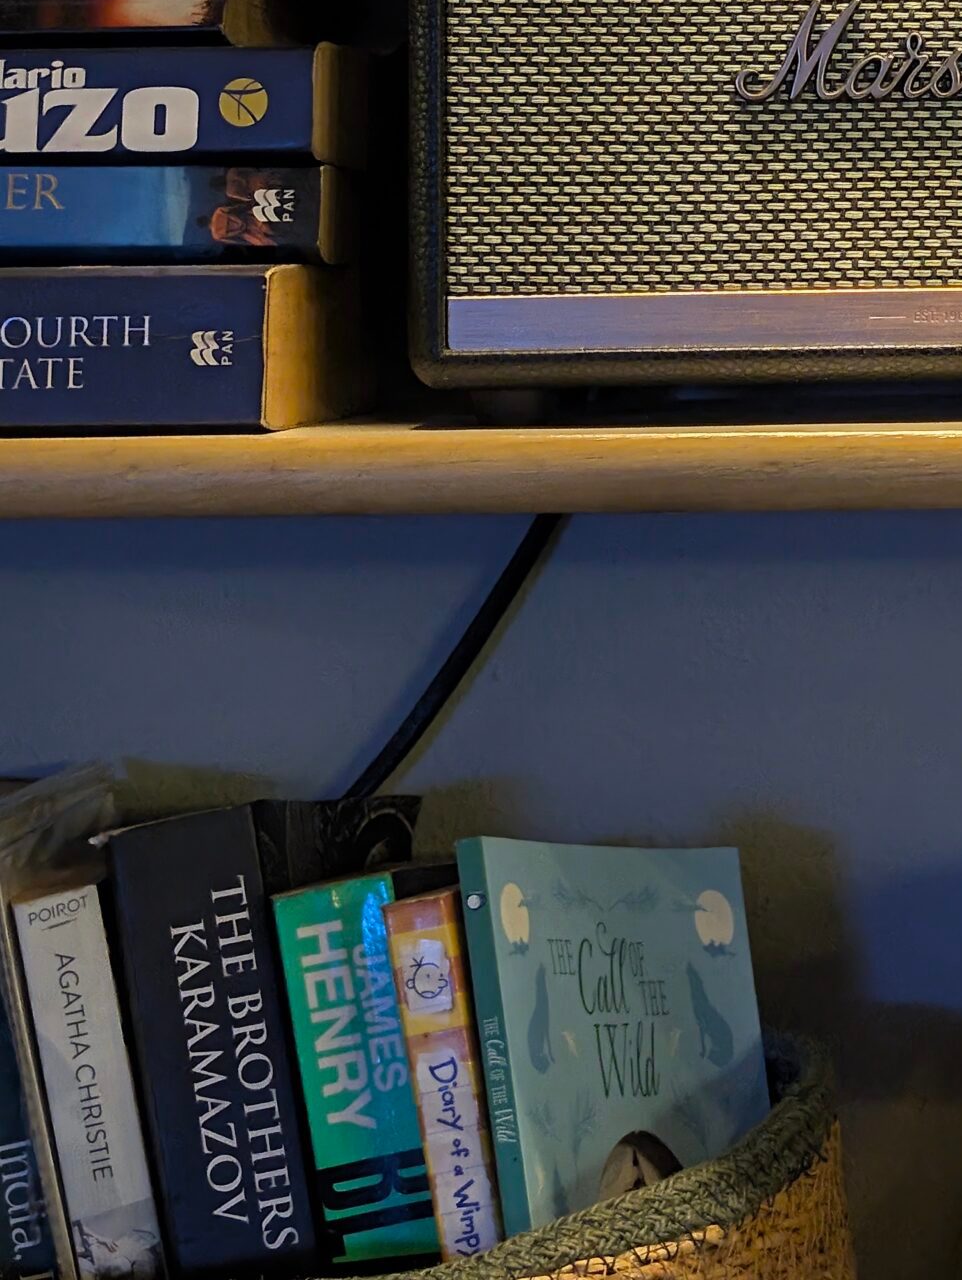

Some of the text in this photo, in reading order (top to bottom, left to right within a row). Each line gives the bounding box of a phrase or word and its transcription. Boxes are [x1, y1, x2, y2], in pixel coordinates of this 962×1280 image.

[281, 188, 297, 223] PAN
[220, 330, 235, 367] PAN
[28, 894, 89, 926] POIROT
[547, 937, 576, 976] THE
[578, 921, 630, 1015] Call
[638, 979, 671, 1017] THE
[296, 919, 378, 1131] HENRY
[351, 944, 409, 1094] JAMES
[483, 1016, 500, 1036] THE
[54, 952, 114, 1182] AGATHA CHRISTIE
[210, 874, 301, 1251] THE BROTHERS
[486, 1039, 508, 1067] Call
[593, 1020, 662, 1099] Wild
[170, 920, 250, 1224] KARAMAZOV
[428, 1056, 462, 1131] Diary
[491, 1085, 508, 1106] THE
[494, 1108, 518, 1144] Wild
[451, 1138, 470, 1158] of
[453, 1165, 465, 1177] a
